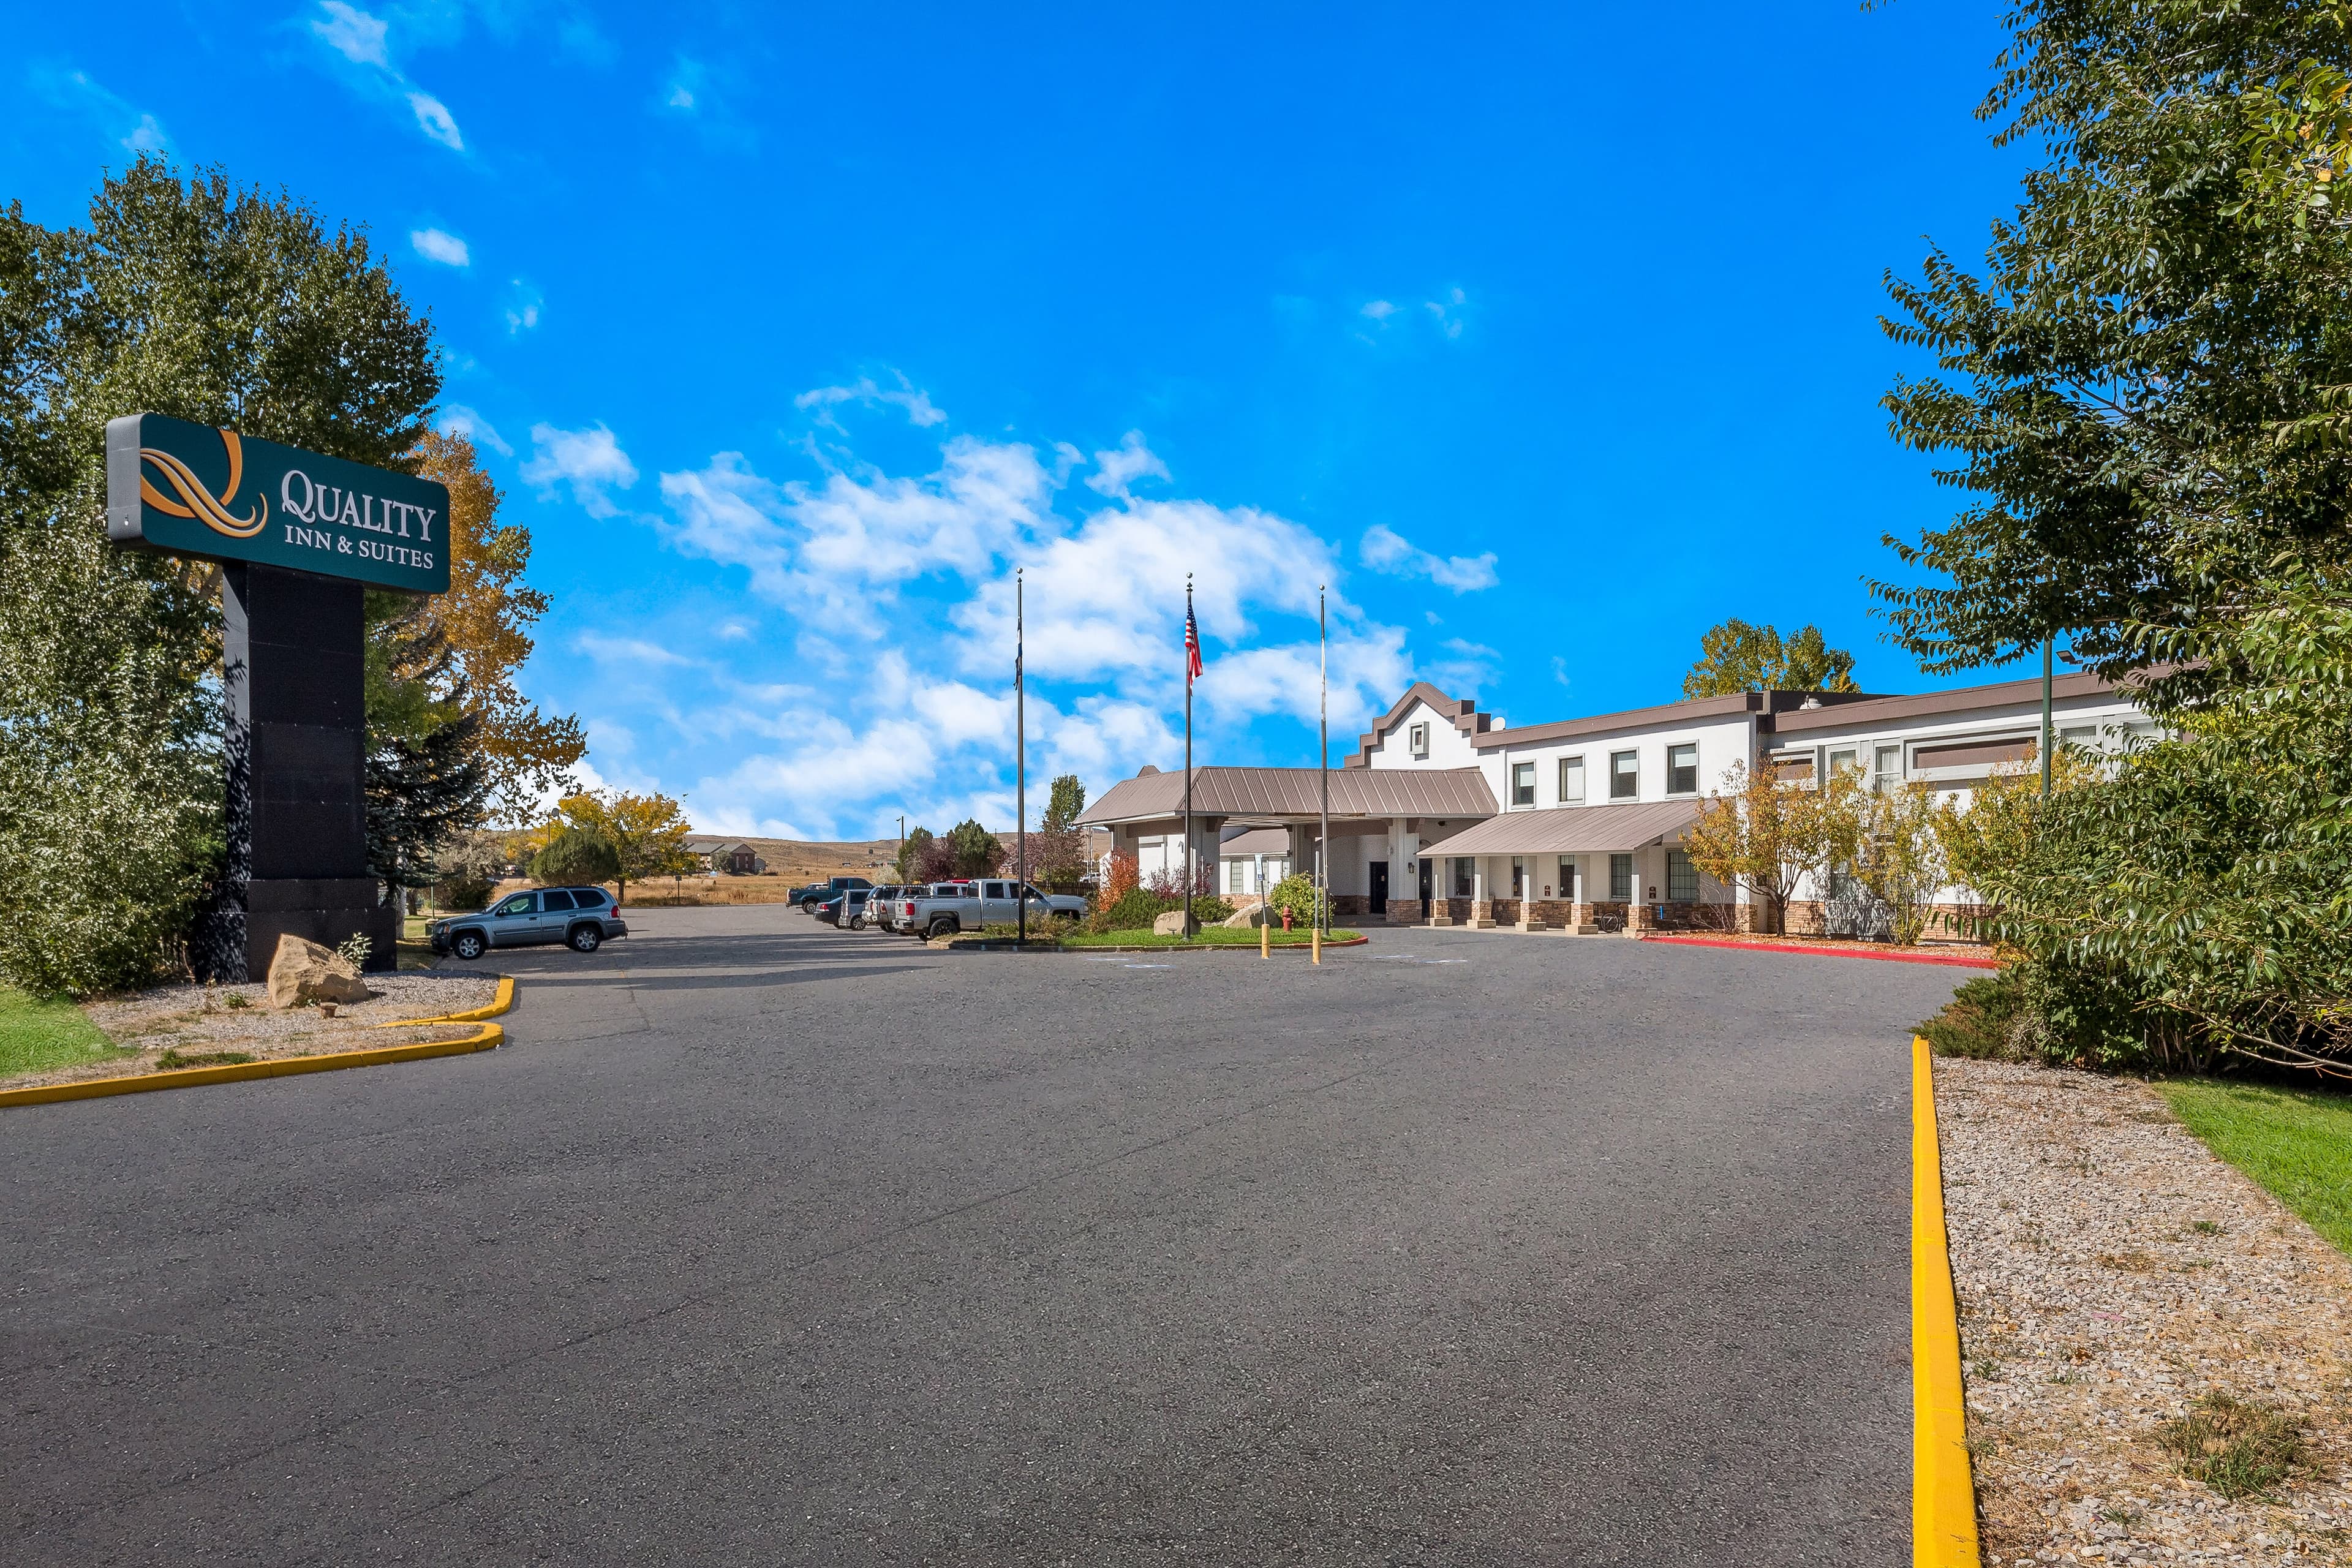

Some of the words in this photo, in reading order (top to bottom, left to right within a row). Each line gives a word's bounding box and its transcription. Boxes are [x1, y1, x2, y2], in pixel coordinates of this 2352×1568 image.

[281, 469, 437, 542] QUALITY
[284, 524, 332, 551] INN
[337, 535, 353, 555] &
[358, 540, 434, 570] SUITES
